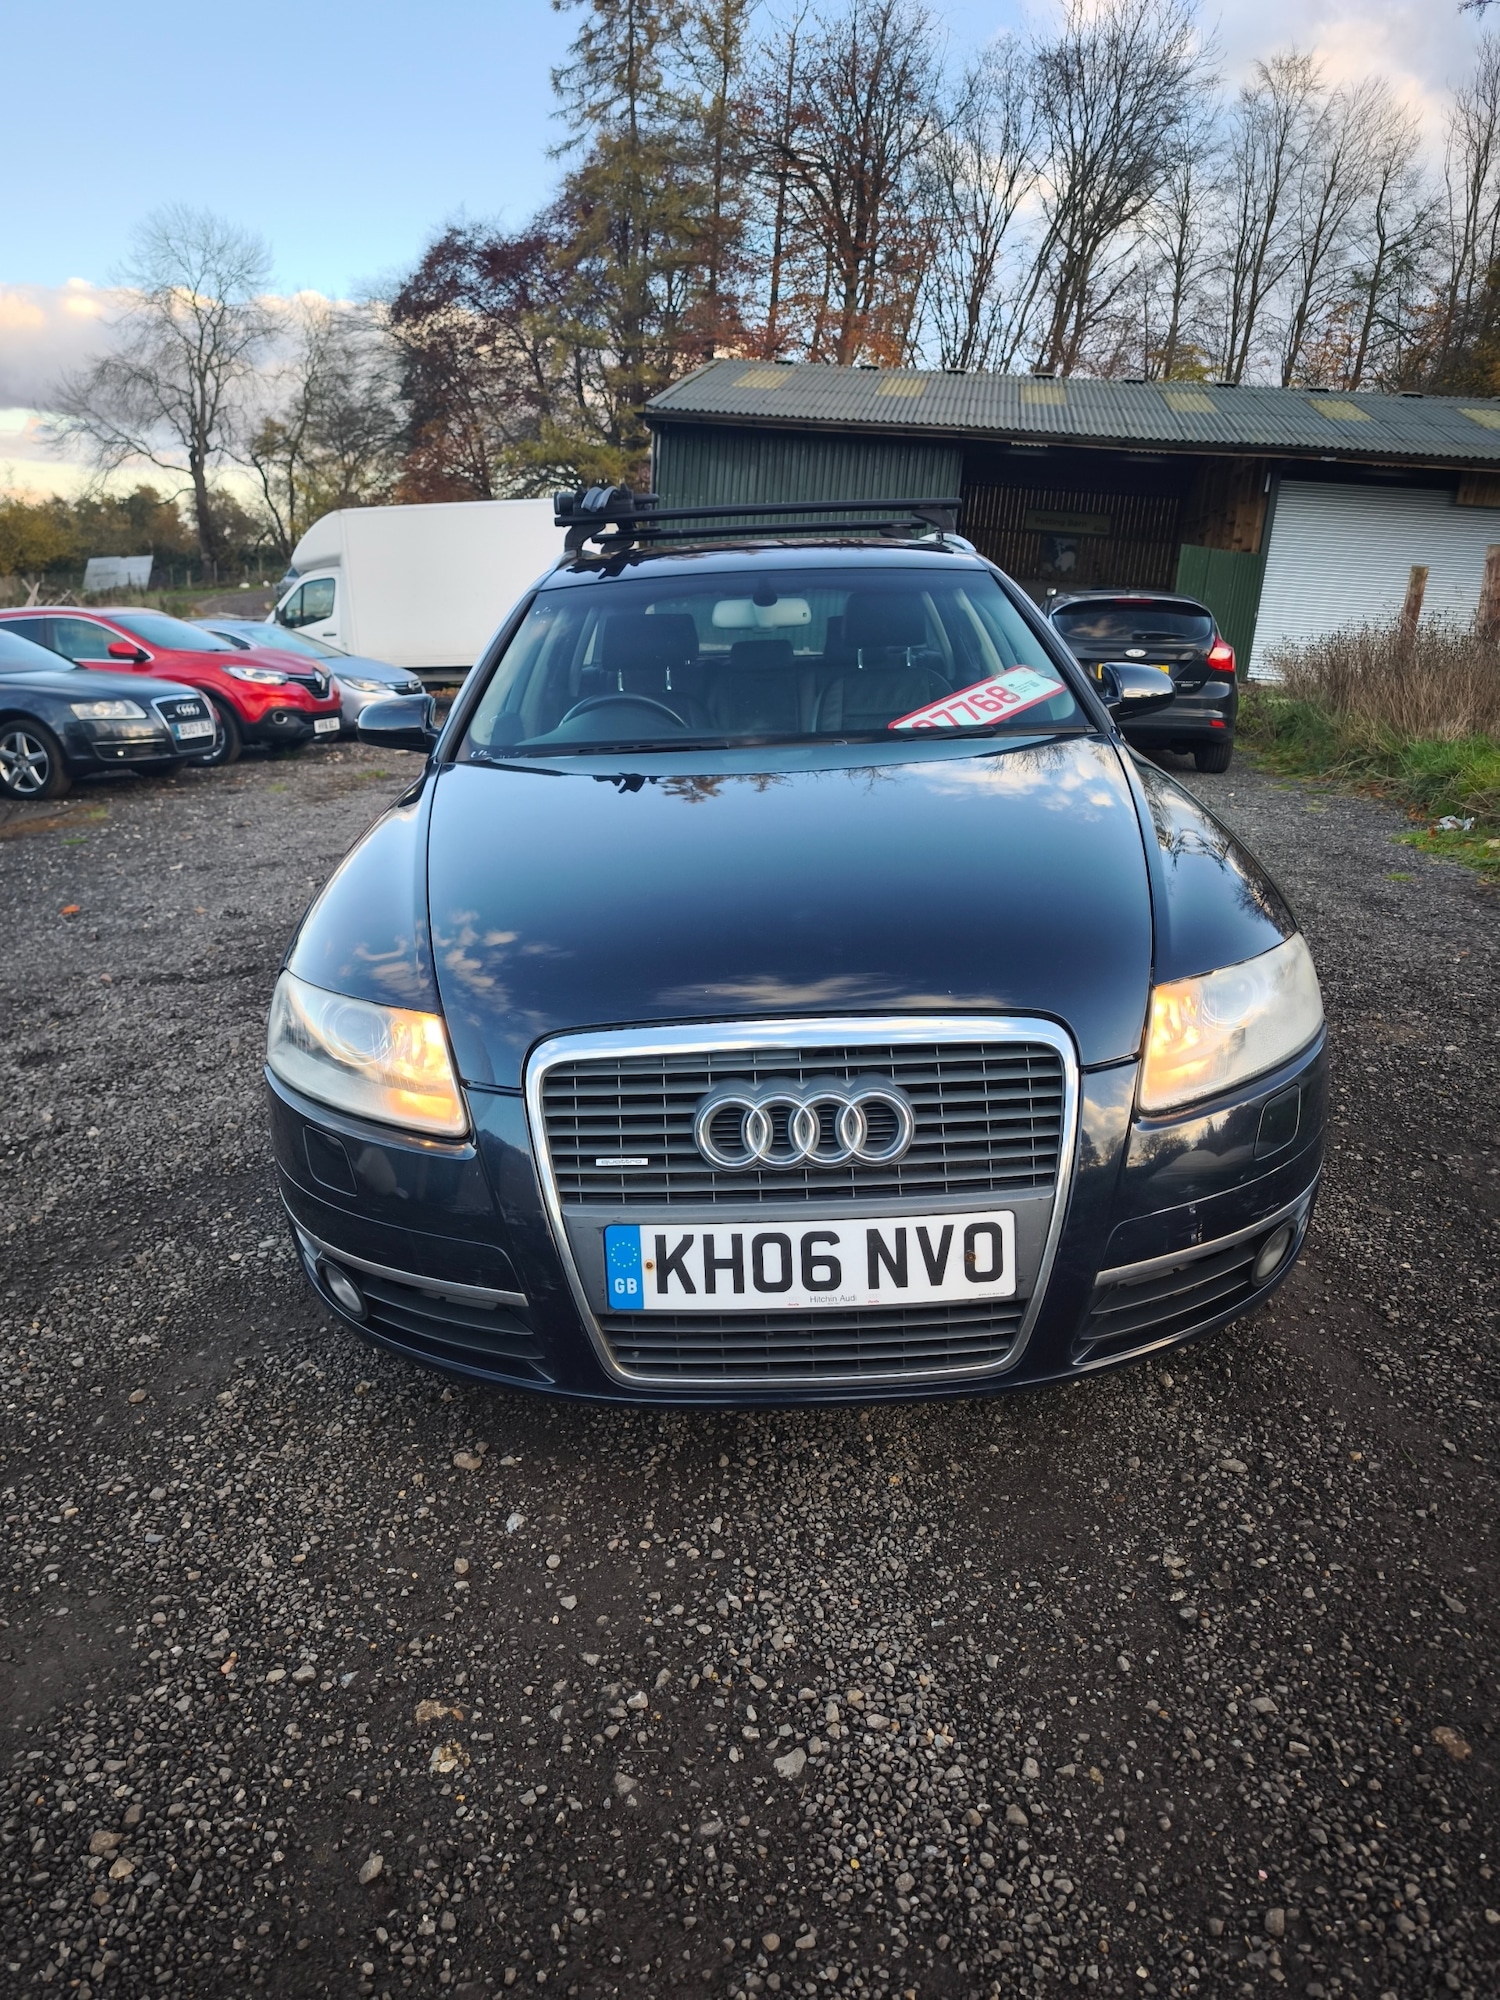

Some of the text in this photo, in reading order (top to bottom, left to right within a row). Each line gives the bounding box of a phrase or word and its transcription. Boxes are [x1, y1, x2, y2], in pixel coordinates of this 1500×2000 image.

[1035, 516, 1088, 527] Petting Barn
[655, 1222, 1004, 1294] KH06 NVO
[614, 1277, 638, 1295] GB
[809, 1295, 837, 1303] Hitchin
